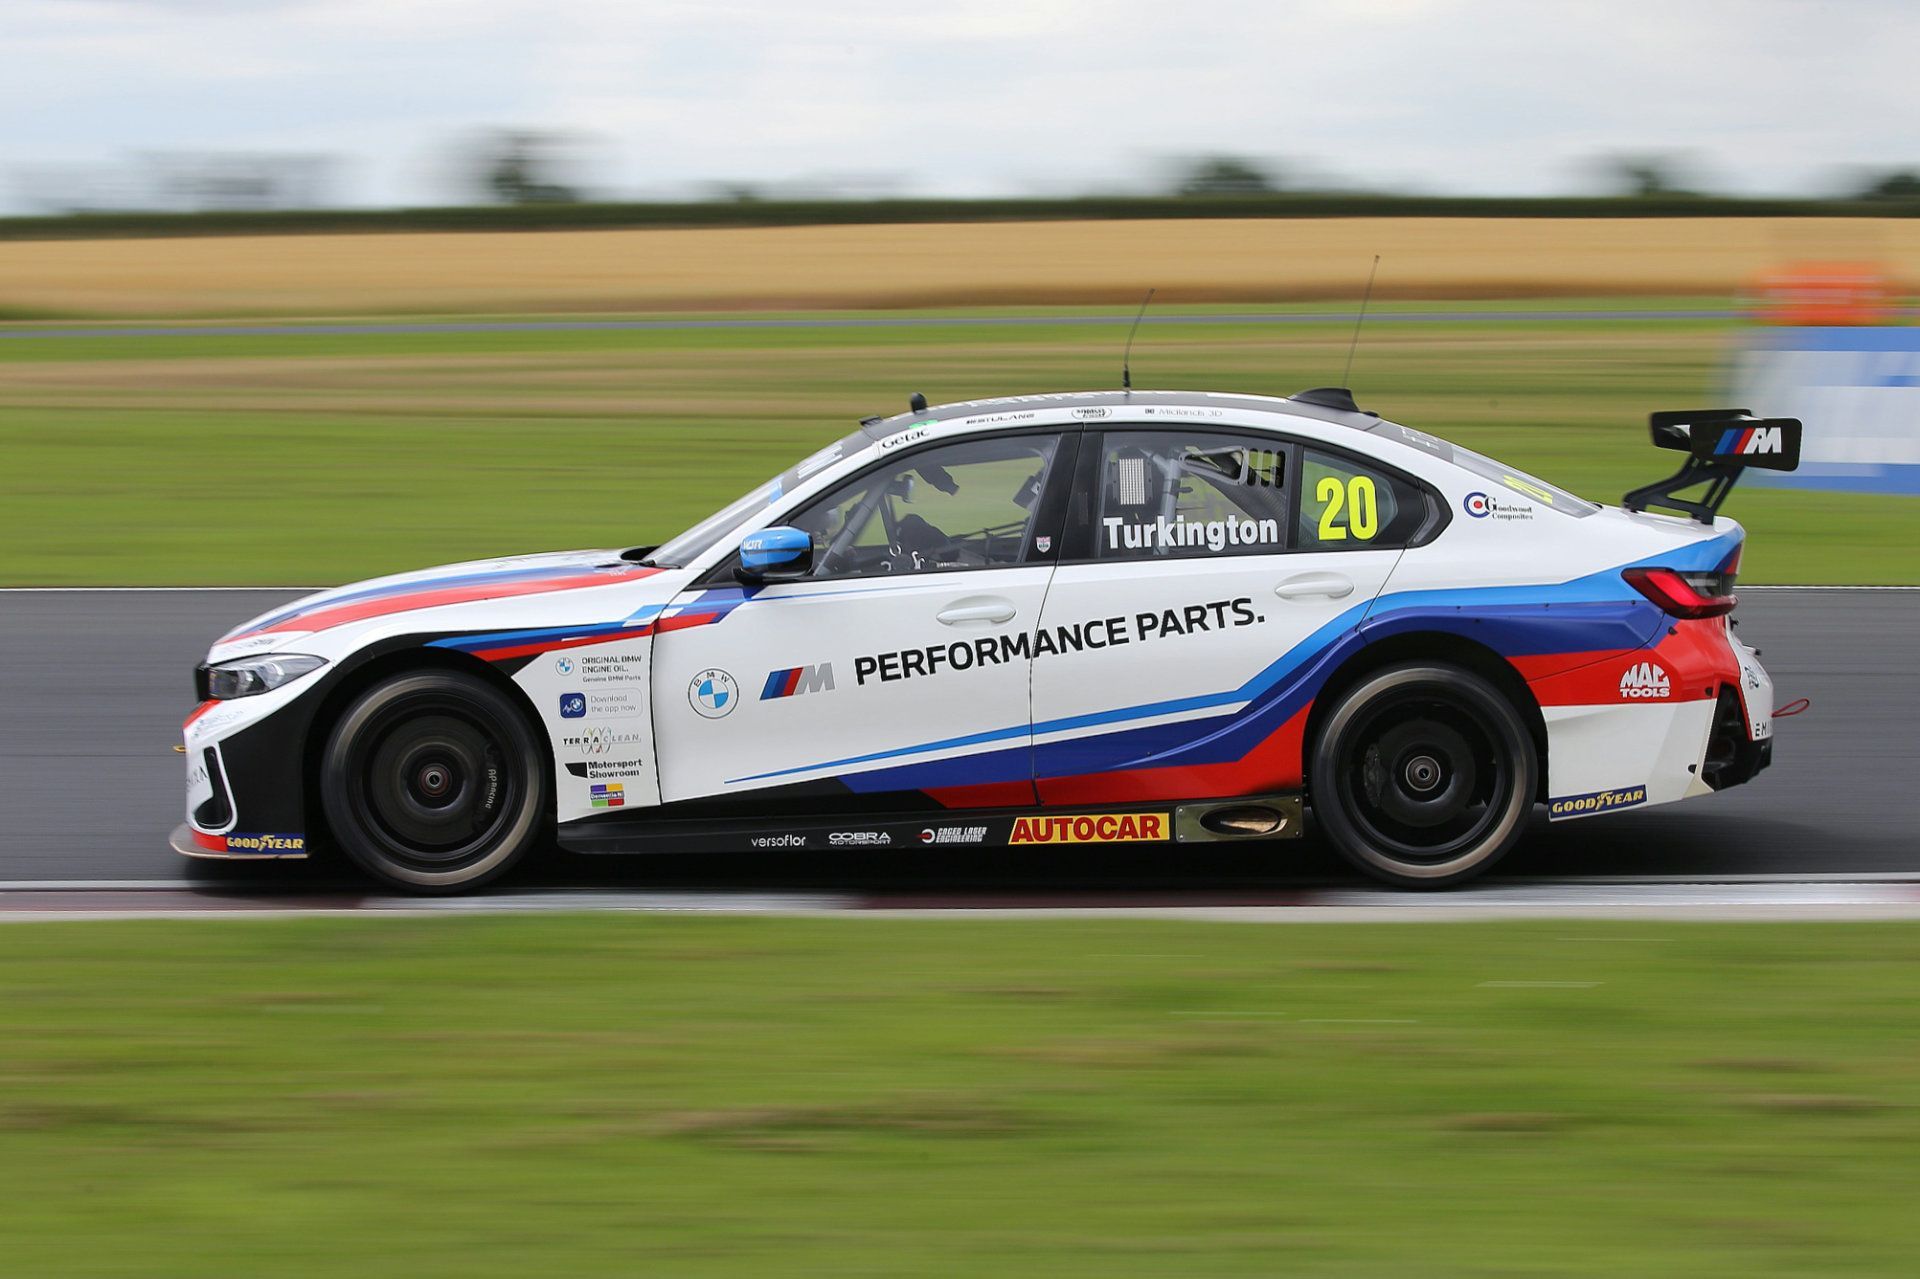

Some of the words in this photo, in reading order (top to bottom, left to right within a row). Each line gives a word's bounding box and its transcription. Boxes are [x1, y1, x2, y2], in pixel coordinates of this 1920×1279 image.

[882, 428, 930, 449] Getac
[1316, 475, 1378, 541] 20
[1485, 497, 1532, 512] Goodwood
[1492, 513, 1533, 521] Composites
[1102, 514, 1278, 552] Turkington
[854, 617, 1129, 685] PERFORMANCE
[1135, 597, 1266, 642] PARTS.
[582, 656, 620, 664] ORIGINAL
[621, 655, 642, 663] BMW
[582, 665, 612, 674] ENGINE
[1620, 662, 1671, 688] MAC
[1620, 688, 1670, 698] TOOLS
[590, 694, 628, 703] Download
[591, 705, 604, 713] the
[604, 705, 619, 713] app
[588, 759, 643, 769] Motorsport
[589, 769, 640, 779] Showroom
[1011, 816, 1161, 842] AUTOCAR
[751, 835, 806, 847] versoflor
[828, 832, 891, 841] COBRA
[935, 834, 983, 843] ENGINEERING
